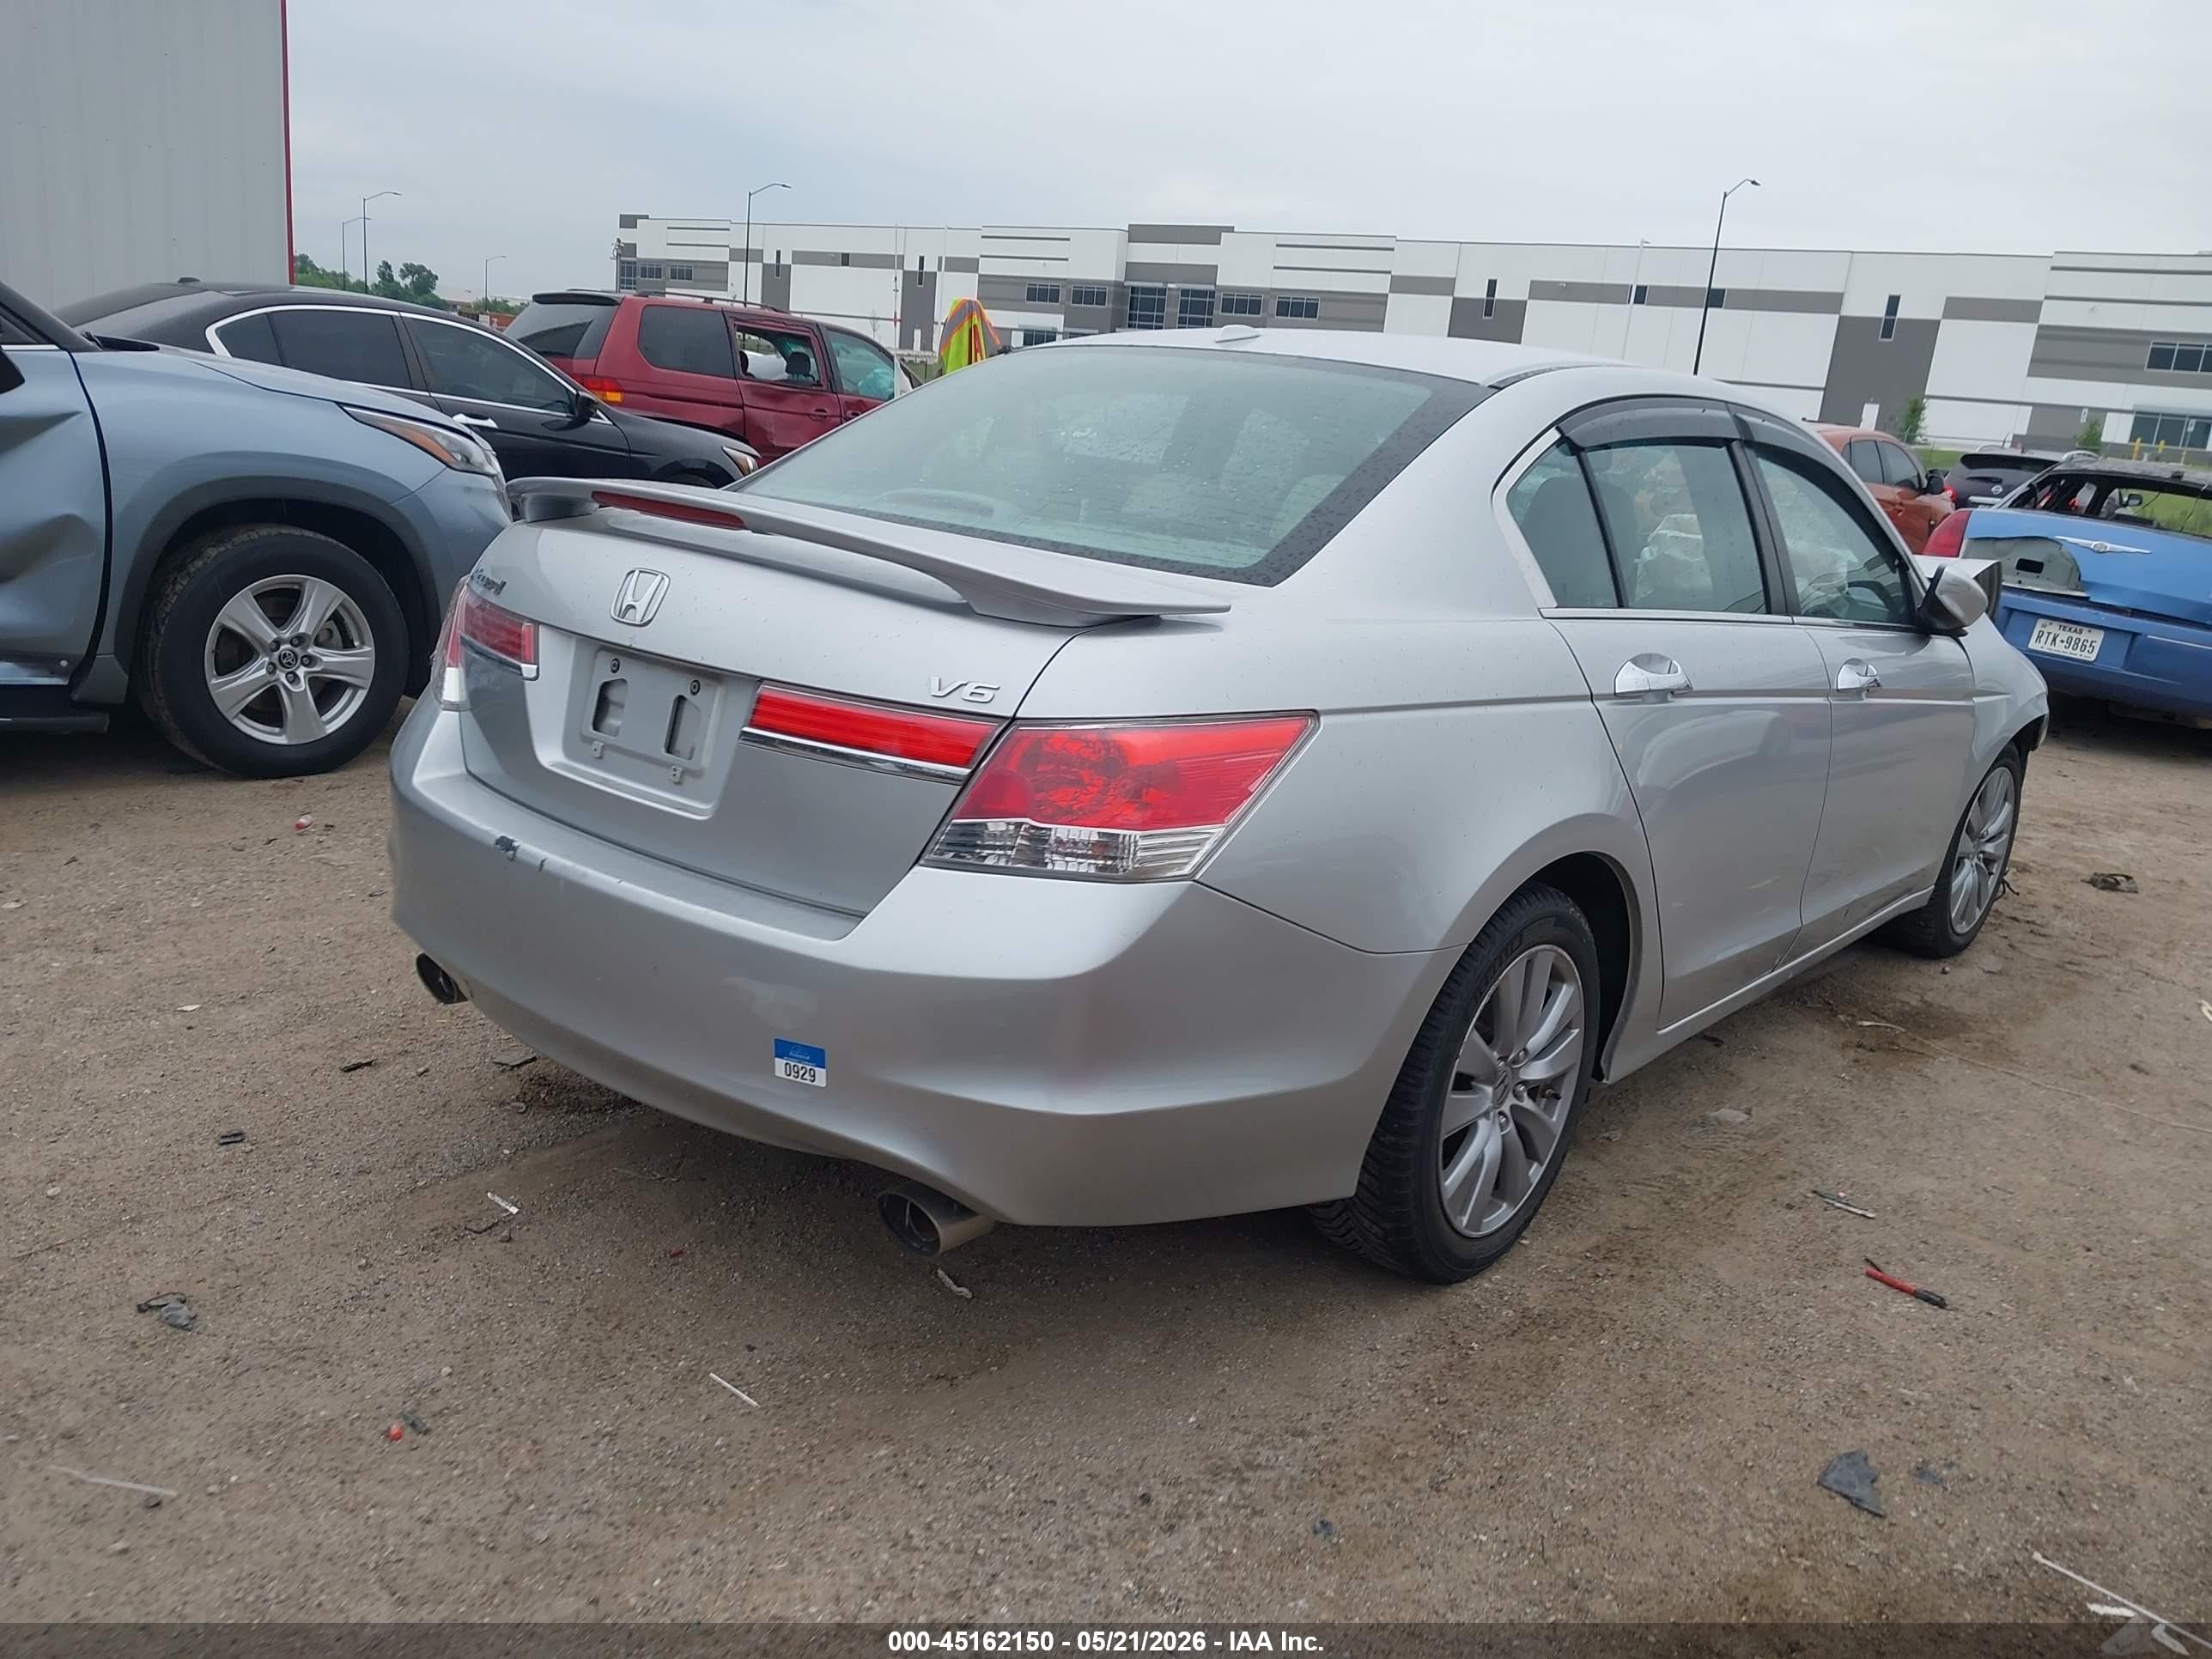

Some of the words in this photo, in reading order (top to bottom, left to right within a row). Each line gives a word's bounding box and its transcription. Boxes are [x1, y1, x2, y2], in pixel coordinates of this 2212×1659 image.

[2058, 624, 2084, 635] TEXAS
[929, 675, 1001, 704] V6
[784, 1061, 817, 1084] 0929
